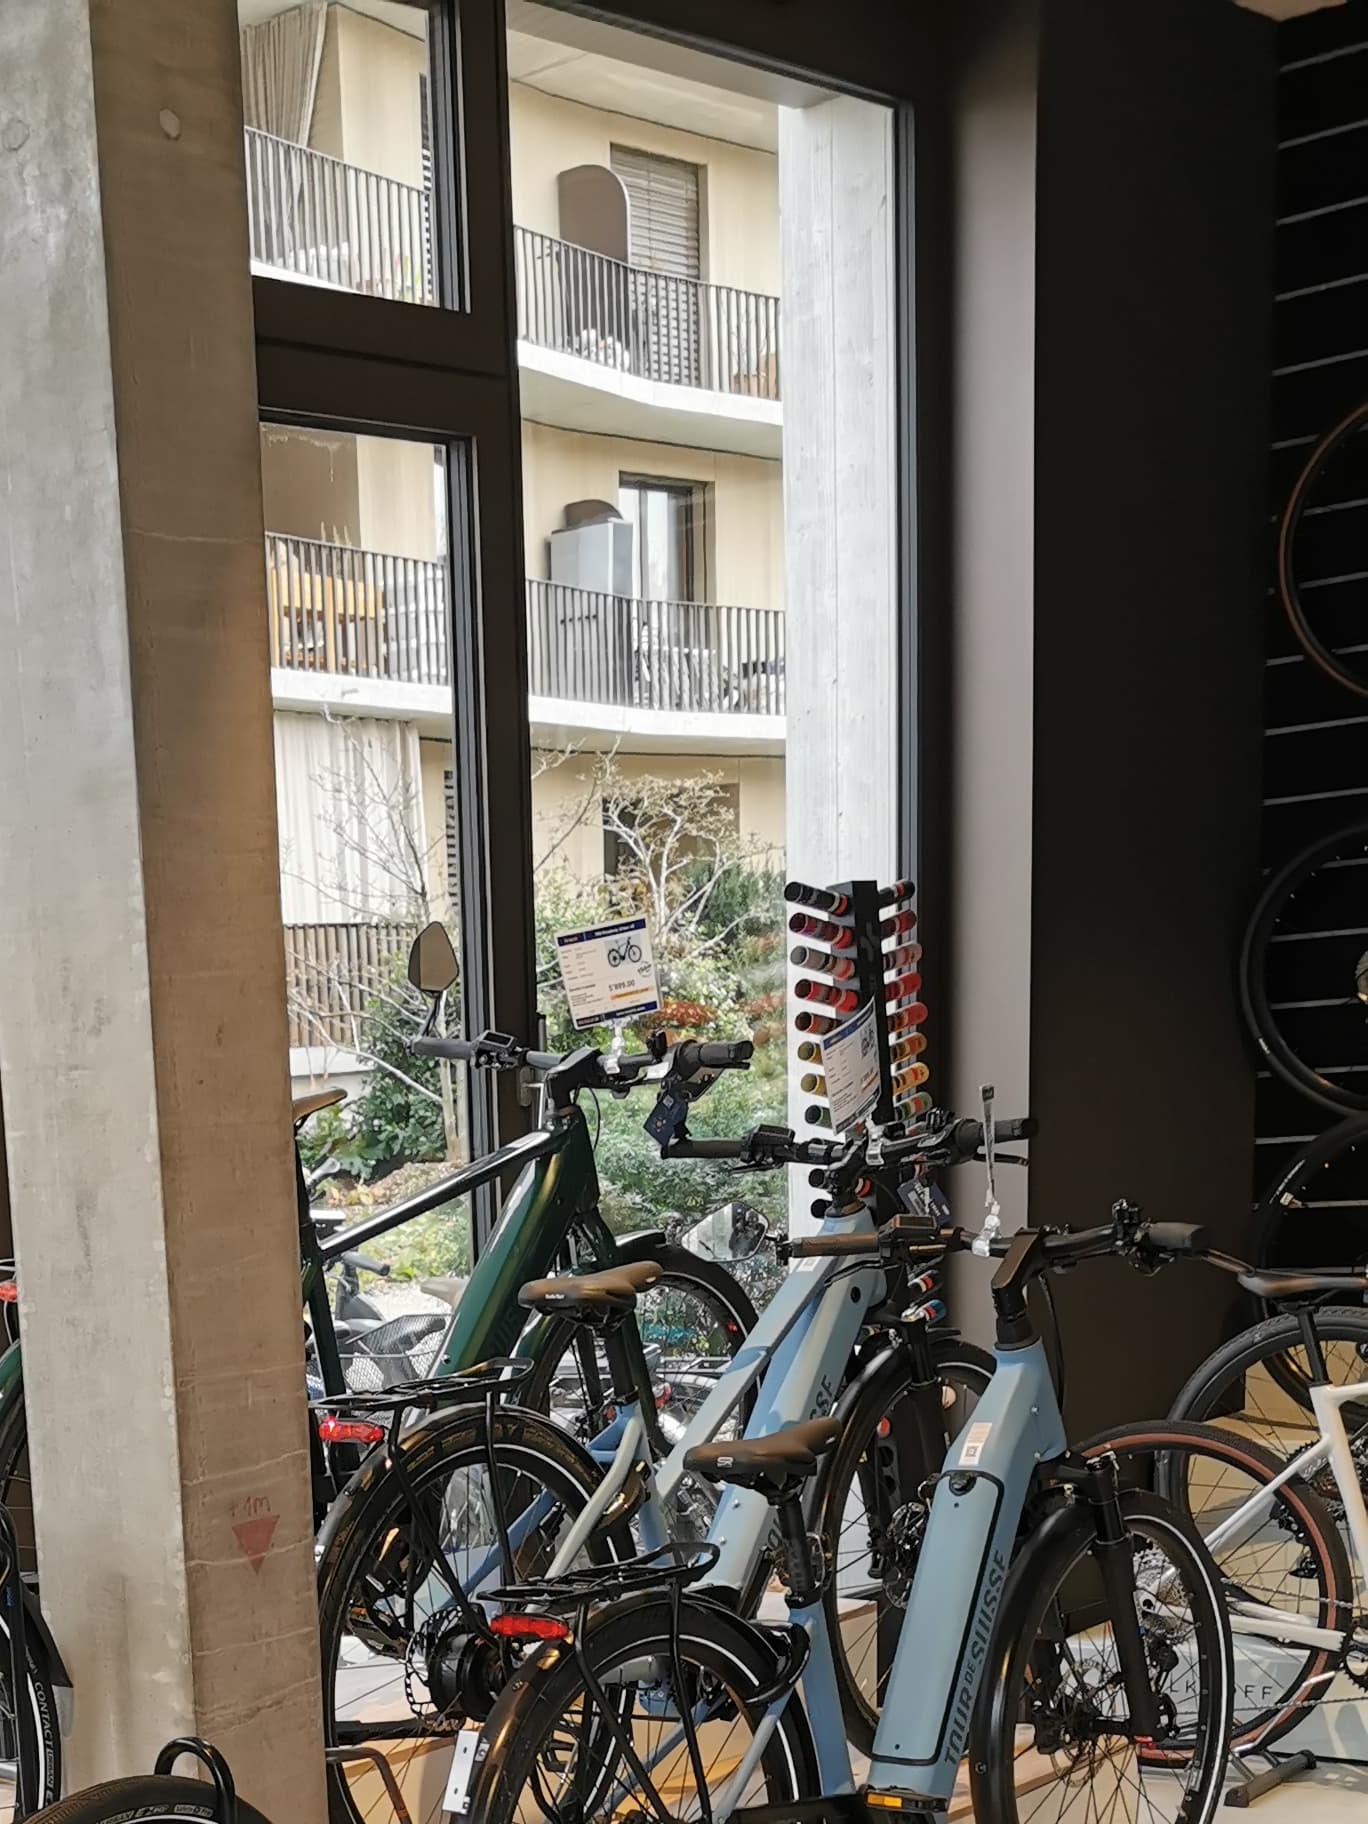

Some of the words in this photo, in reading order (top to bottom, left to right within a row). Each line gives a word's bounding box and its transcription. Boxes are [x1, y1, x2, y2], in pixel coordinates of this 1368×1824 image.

[970, 1549, 1006, 1665] SUISSE
[964, 1660, 977, 1684] DE
[34, 1681, 54, 1748] CONTACT
[944, 1688, 974, 1765] TOUR
